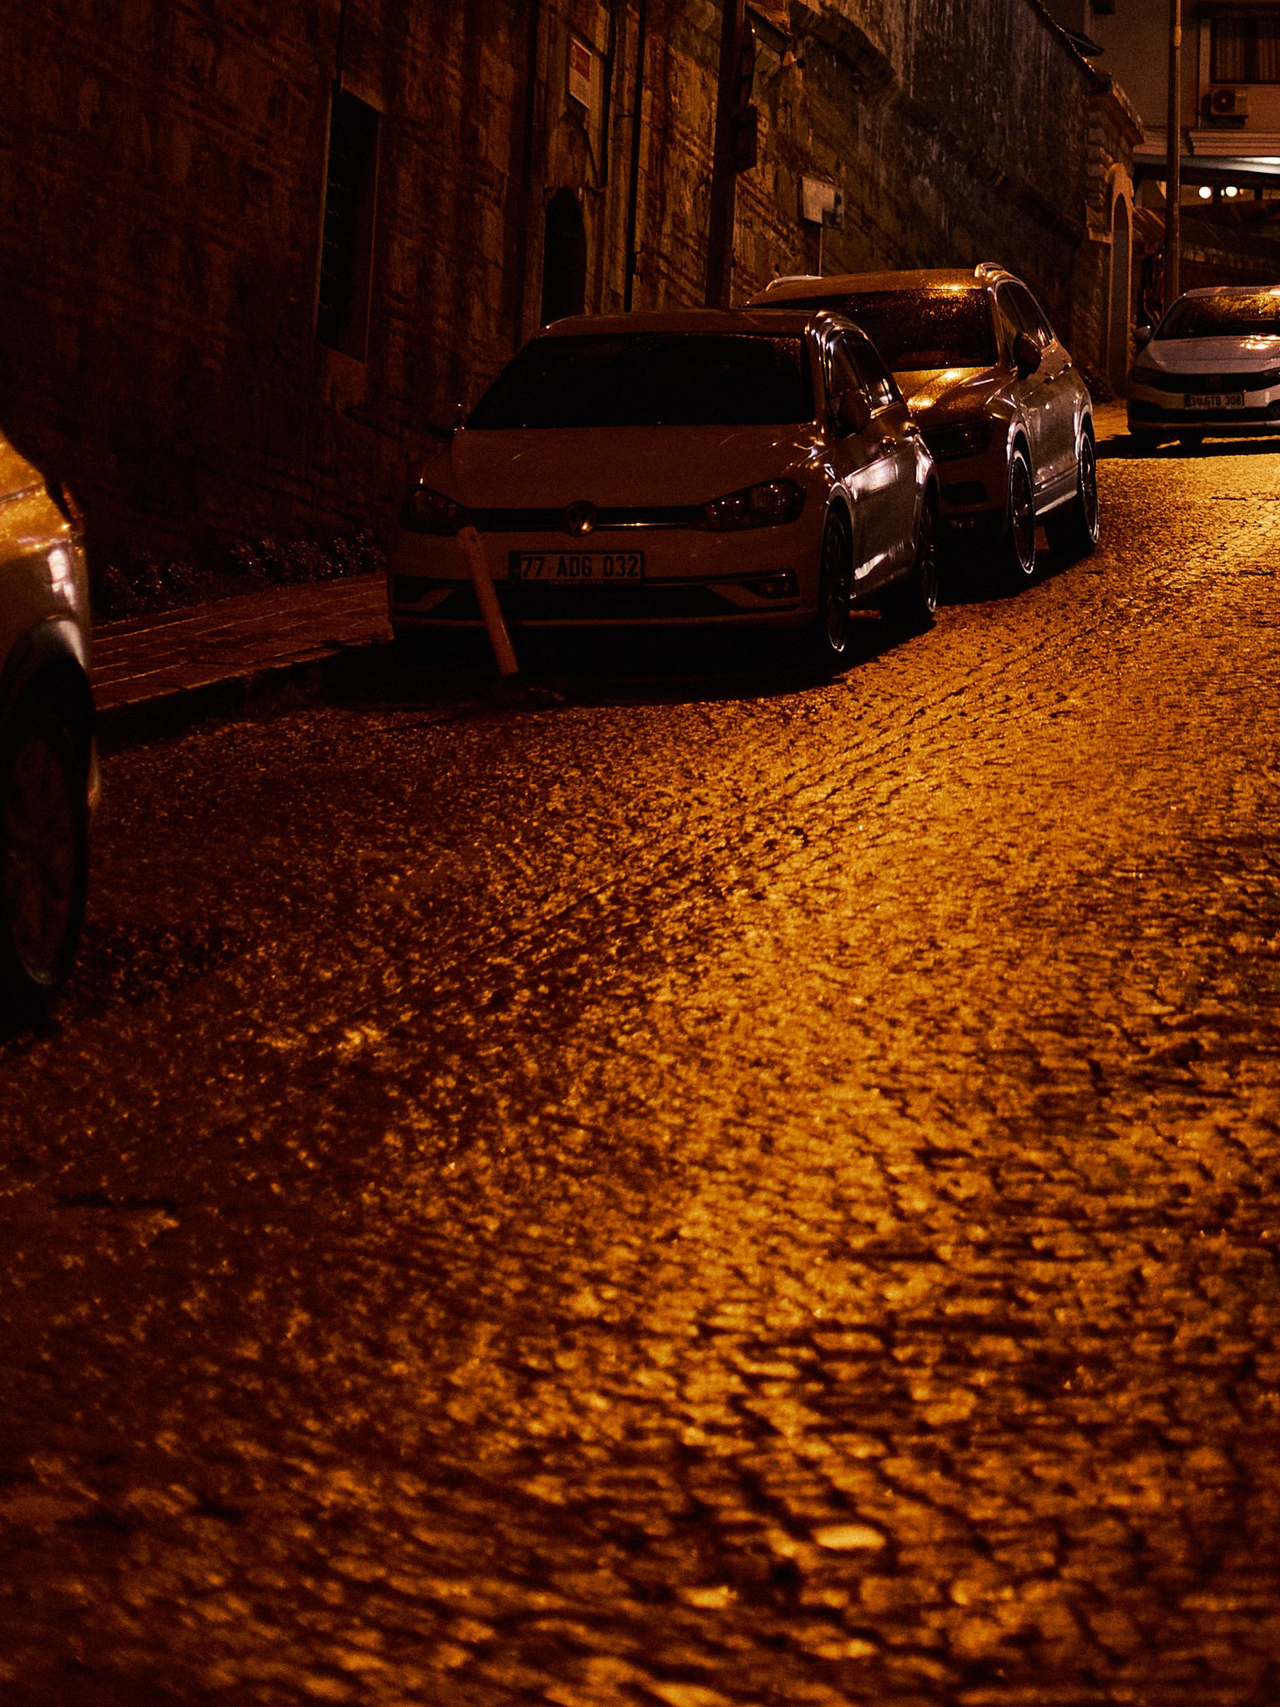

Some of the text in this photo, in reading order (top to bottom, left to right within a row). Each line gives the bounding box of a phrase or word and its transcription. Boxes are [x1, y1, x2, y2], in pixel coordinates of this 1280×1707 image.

[522, 556, 639, 577] 77 ADG 032
